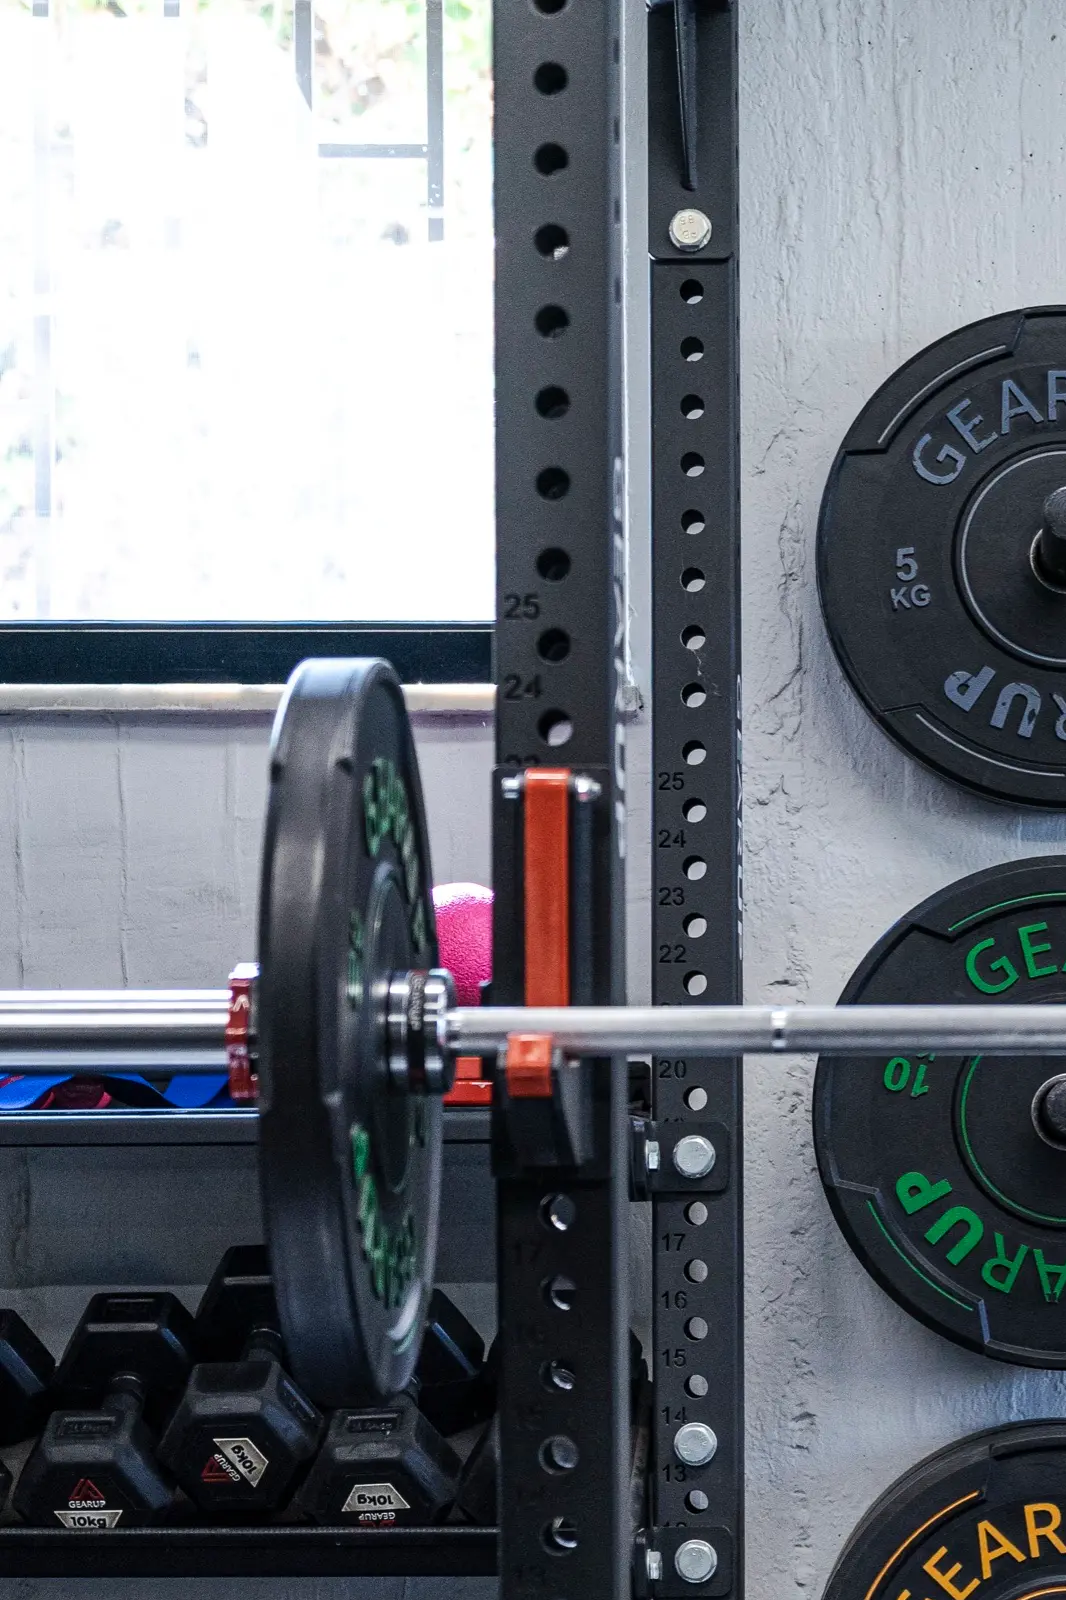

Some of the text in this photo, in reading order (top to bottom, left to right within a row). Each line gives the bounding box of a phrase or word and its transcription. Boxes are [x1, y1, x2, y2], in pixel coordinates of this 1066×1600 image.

[895, 547, 918, 581] 5
[504, 594, 540, 620] 25
[890, 585, 931, 610] KG
[504, 674, 542, 699] 24
[658, 772, 685, 791] 25
[658, 829, 686, 848] 24
[658, 887, 685, 906] 23
[659, 944, 687, 963] 22
[659, 1060, 687, 1079] 20
[884, 1056, 929, 1097] 10
[661, 1233, 686, 1252] 17
[661, 1291, 687, 1310] 16
[661, 1349, 687, 1367] 15
[661, 1406, 687, 1425] 14
[213, 1453, 240, 1481] GEARUP
[231, 1445, 257, 1474] 10kg
[662, 1464, 687, 1483] 13
[68, 1500, 106, 1508] GEARUP
[357, 1493, 394, 1506] 10kg
[70, 1516, 107, 1528] 10kg
[358, 1511, 396, 1520] GEARUP
